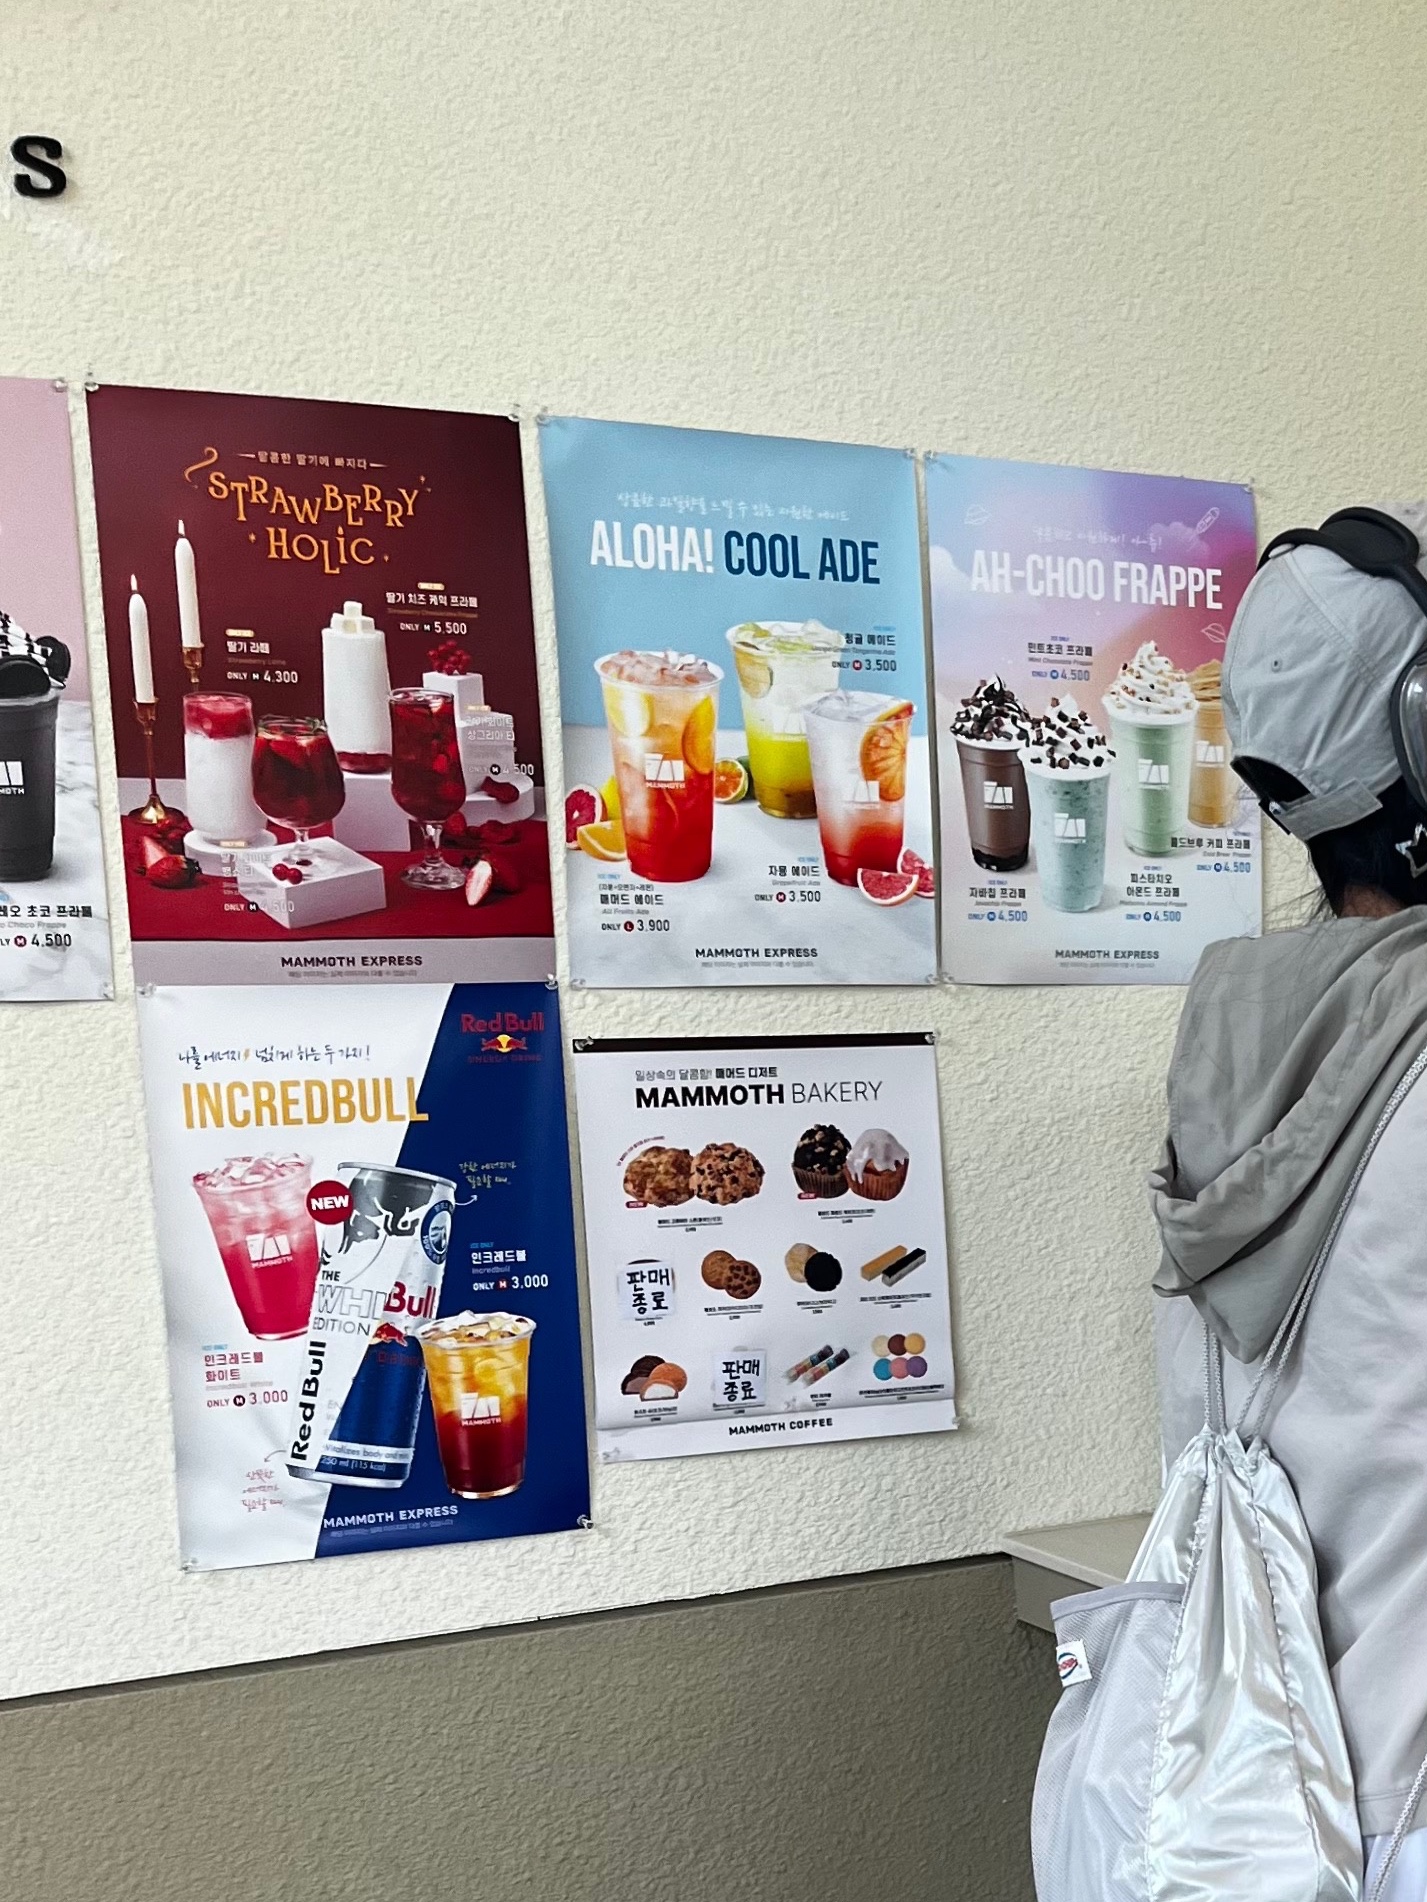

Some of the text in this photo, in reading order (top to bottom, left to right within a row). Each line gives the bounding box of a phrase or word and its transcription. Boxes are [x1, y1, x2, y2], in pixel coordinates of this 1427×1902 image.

[206, 471, 419, 527] STRAWBERRY
[266, 526, 375, 574] HOLIC
[590, 519, 880, 584] ALOHA! COOL ADE
[970, 549, 1223, 610] AH-CHOO FRAPPE
[281, 955, 423, 968] MAMMOTH EXPRESS
[695, 948, 819, 959] MAMMOTH EXPRESS
[1055, 950, 1160, 960] MAMMOTH EXPRESS
[461, 1011, 544, 1032] Red Bull
[178, 1046, 202, 1070] 나를
[204, 1050, 241, 1064] 에너지
[297, 1044, 321, 1063] 하는
[324, 1044, 335, 1065] 두
[182, 1077, 429, 1129] INCREDBULL
[635, 1080, 883, 1109] MAMMOTH BAKERY
[311, 1196, 350, 1211] NEW
[252, 1256, 293, 1269] MAMMOTH
[471, 1250, 527, 1265] 인크레드불
[321, 1270, 341, 1282] THE
[473, 1282, 495, 1291] ONLY
[626, 1267, 671, 1292] 판매
[383, 1281, 437, 1319] Bull
[313, 1317, 371, 1336] EDITION
[204, 1351, 264, 1367] 인크레드불
[722, 1359, 760, 1380] 판매
[205, 1369, 241, 1383] 화이트
[290, 1340, 327, 1461] Red Bull
[723, 1381, 757, 1402] 종료
[207, 1398, 230, 1408] ONLY
[728, 1417, 833, 1436] MAMMOTH COFFEE
[323, 1512, 394, 1529] MAMMOTH
[399, 1505, 458, 1521] EXPRESS
